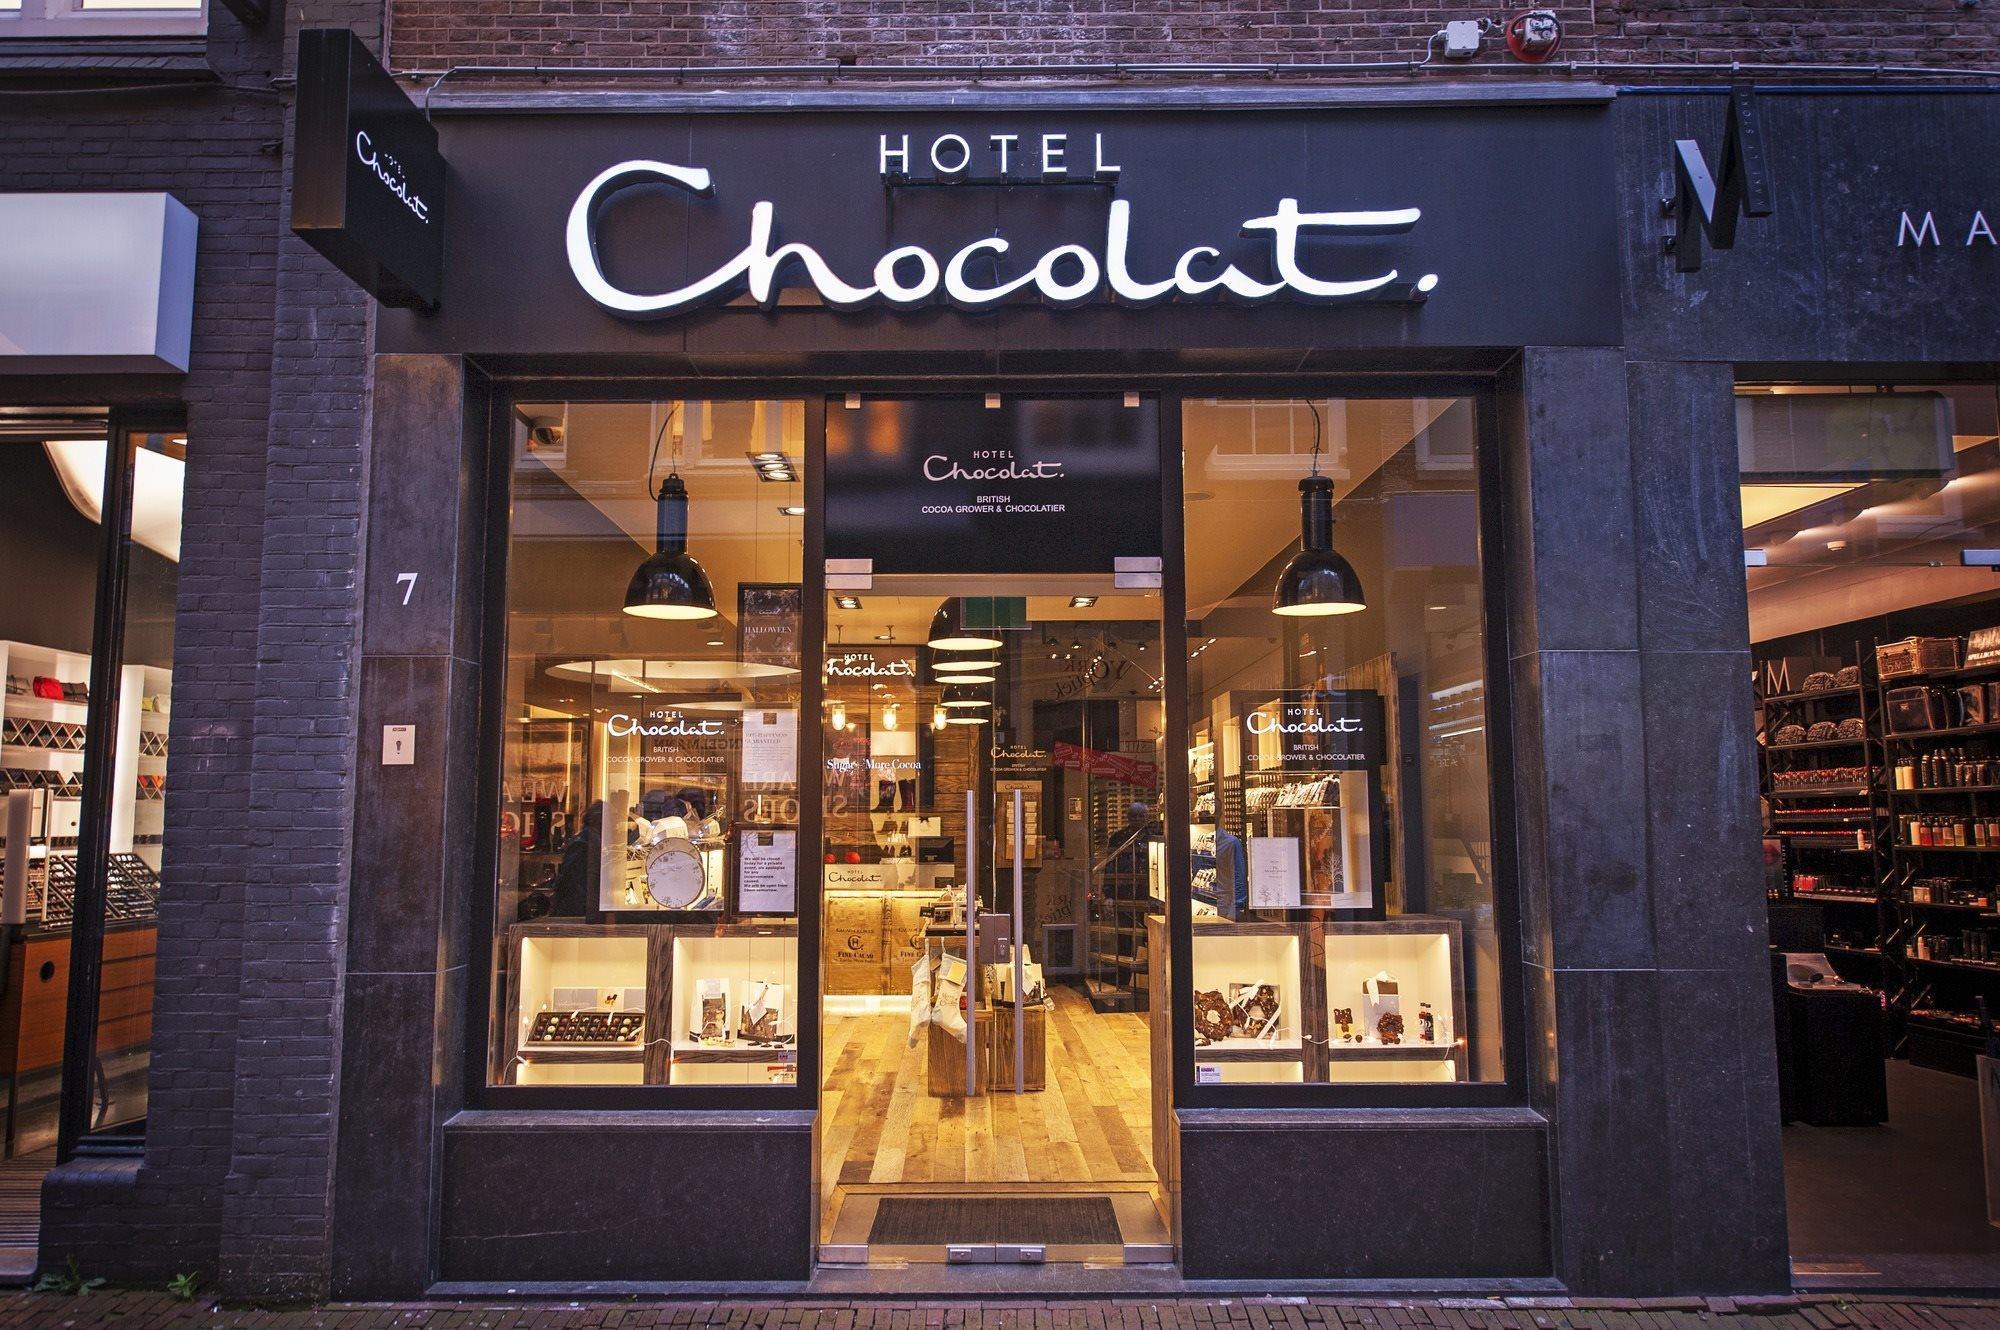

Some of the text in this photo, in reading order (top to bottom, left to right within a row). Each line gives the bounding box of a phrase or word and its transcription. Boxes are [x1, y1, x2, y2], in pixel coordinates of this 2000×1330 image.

[879, 133, 1122, 175] HOTEL
[972, 450, 1015, 459] HOTEL
[976, 494, 1012, 504] BRITISH
[921, 503, 1066, 514] COCOA GROWER & CHOCOLATIER
[395, 572, 419, 606] 7
[744, 626, 792, 634] HALLOWEEN
[843, 653, 875, 661] HOTEL
[649, 710, 684, 719] HOTEL
[1287, 707, 1322, 716] HOTEL
[1315, 753, 1366, 761] CHOCOLATIER
